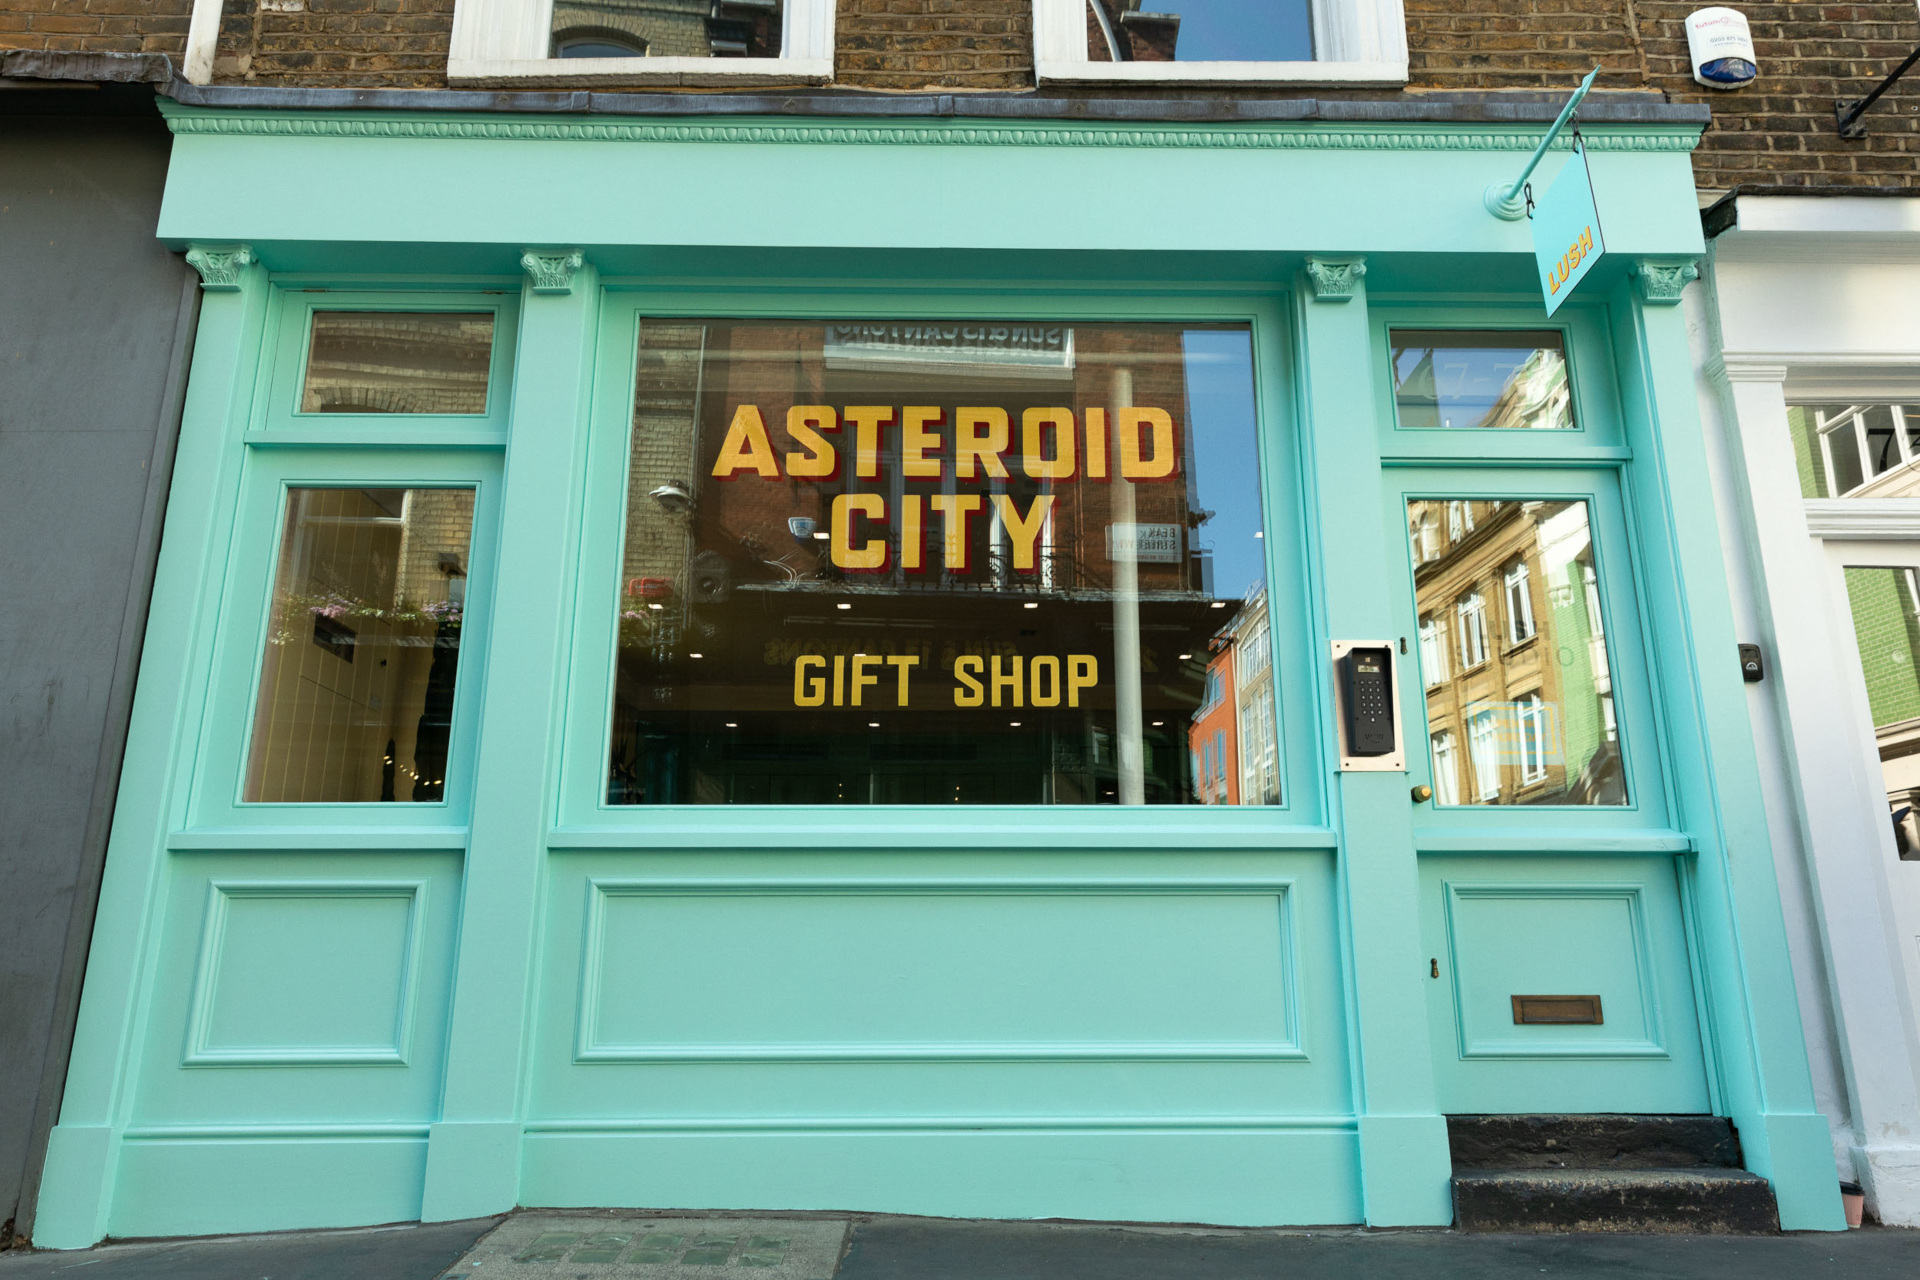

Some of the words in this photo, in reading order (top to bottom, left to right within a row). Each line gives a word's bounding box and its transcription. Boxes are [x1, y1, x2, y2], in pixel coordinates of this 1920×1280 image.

[1548, 225, 1593, 295] LUSH
[711, 404, 1180, 482] ASTEROID
[830, 493, 1060, 574] CITY
[794, 654, 920, 707] GIFT
[953, 654, 1099, 707] SHOP
